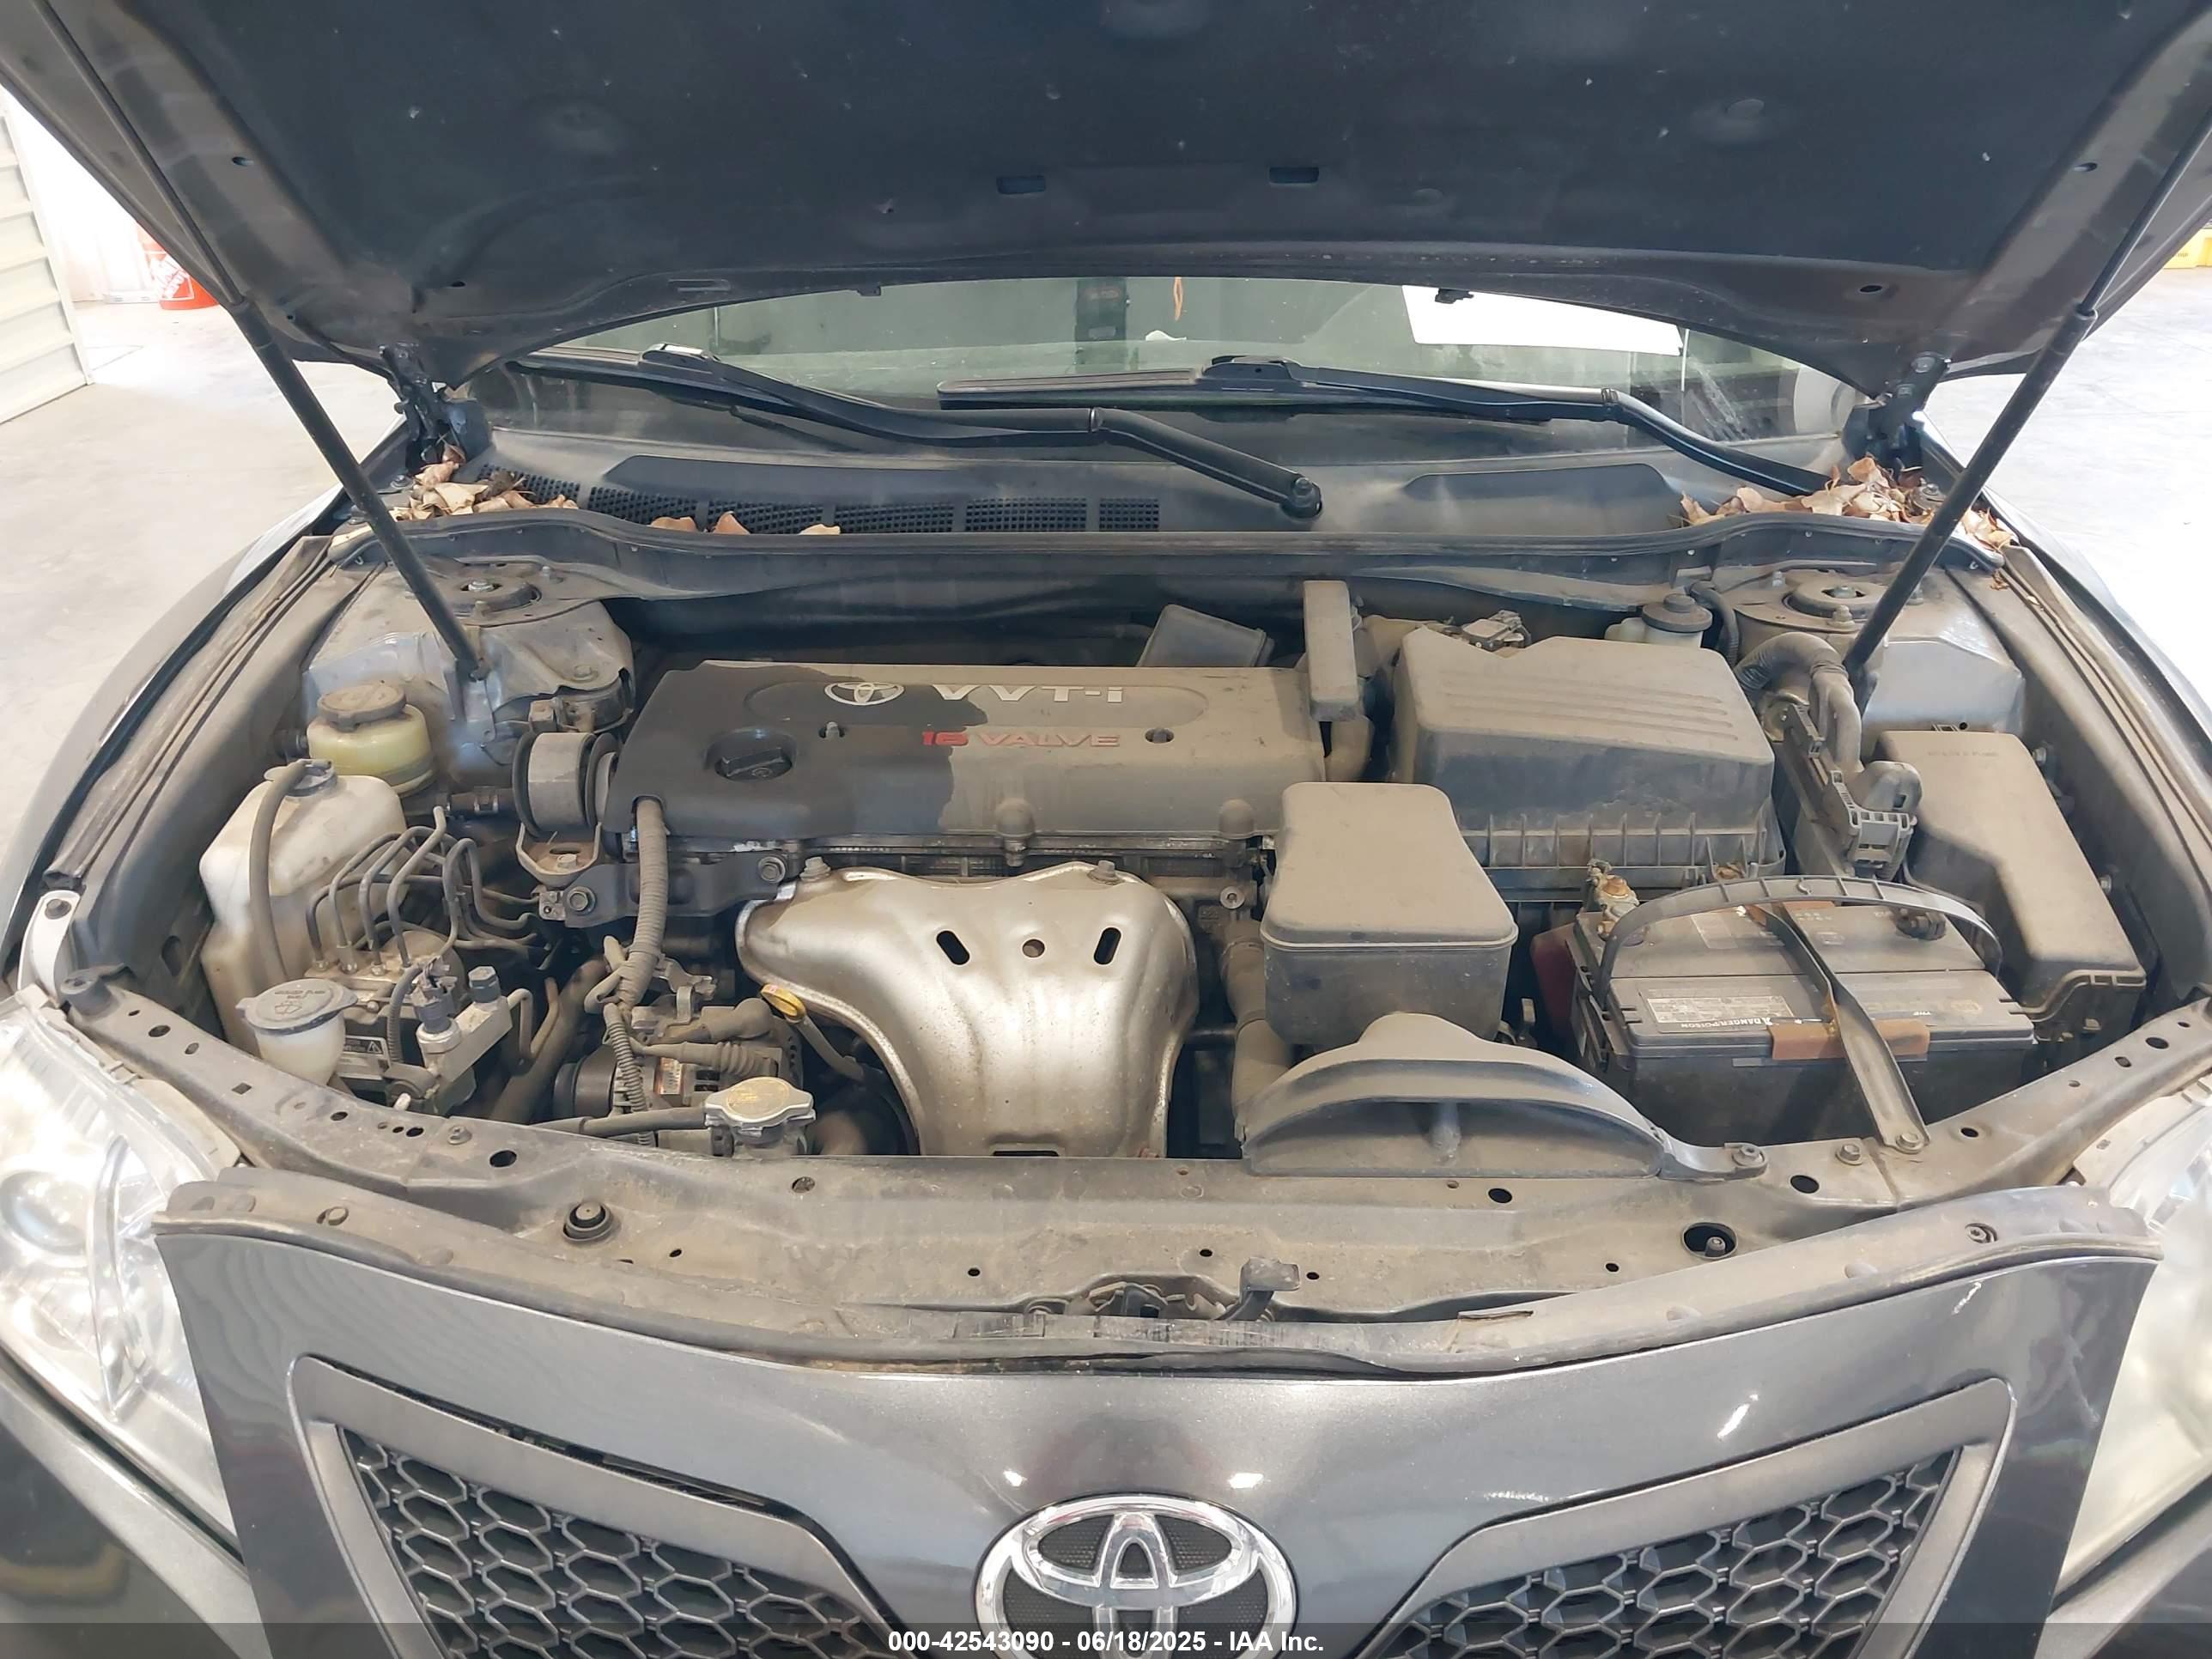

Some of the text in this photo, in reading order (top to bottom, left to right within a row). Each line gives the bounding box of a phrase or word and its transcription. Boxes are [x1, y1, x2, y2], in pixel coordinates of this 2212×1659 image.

[933, 684, 1122, 702] VVT-i
[922, 732, 1120, 747] 16 VALVE
